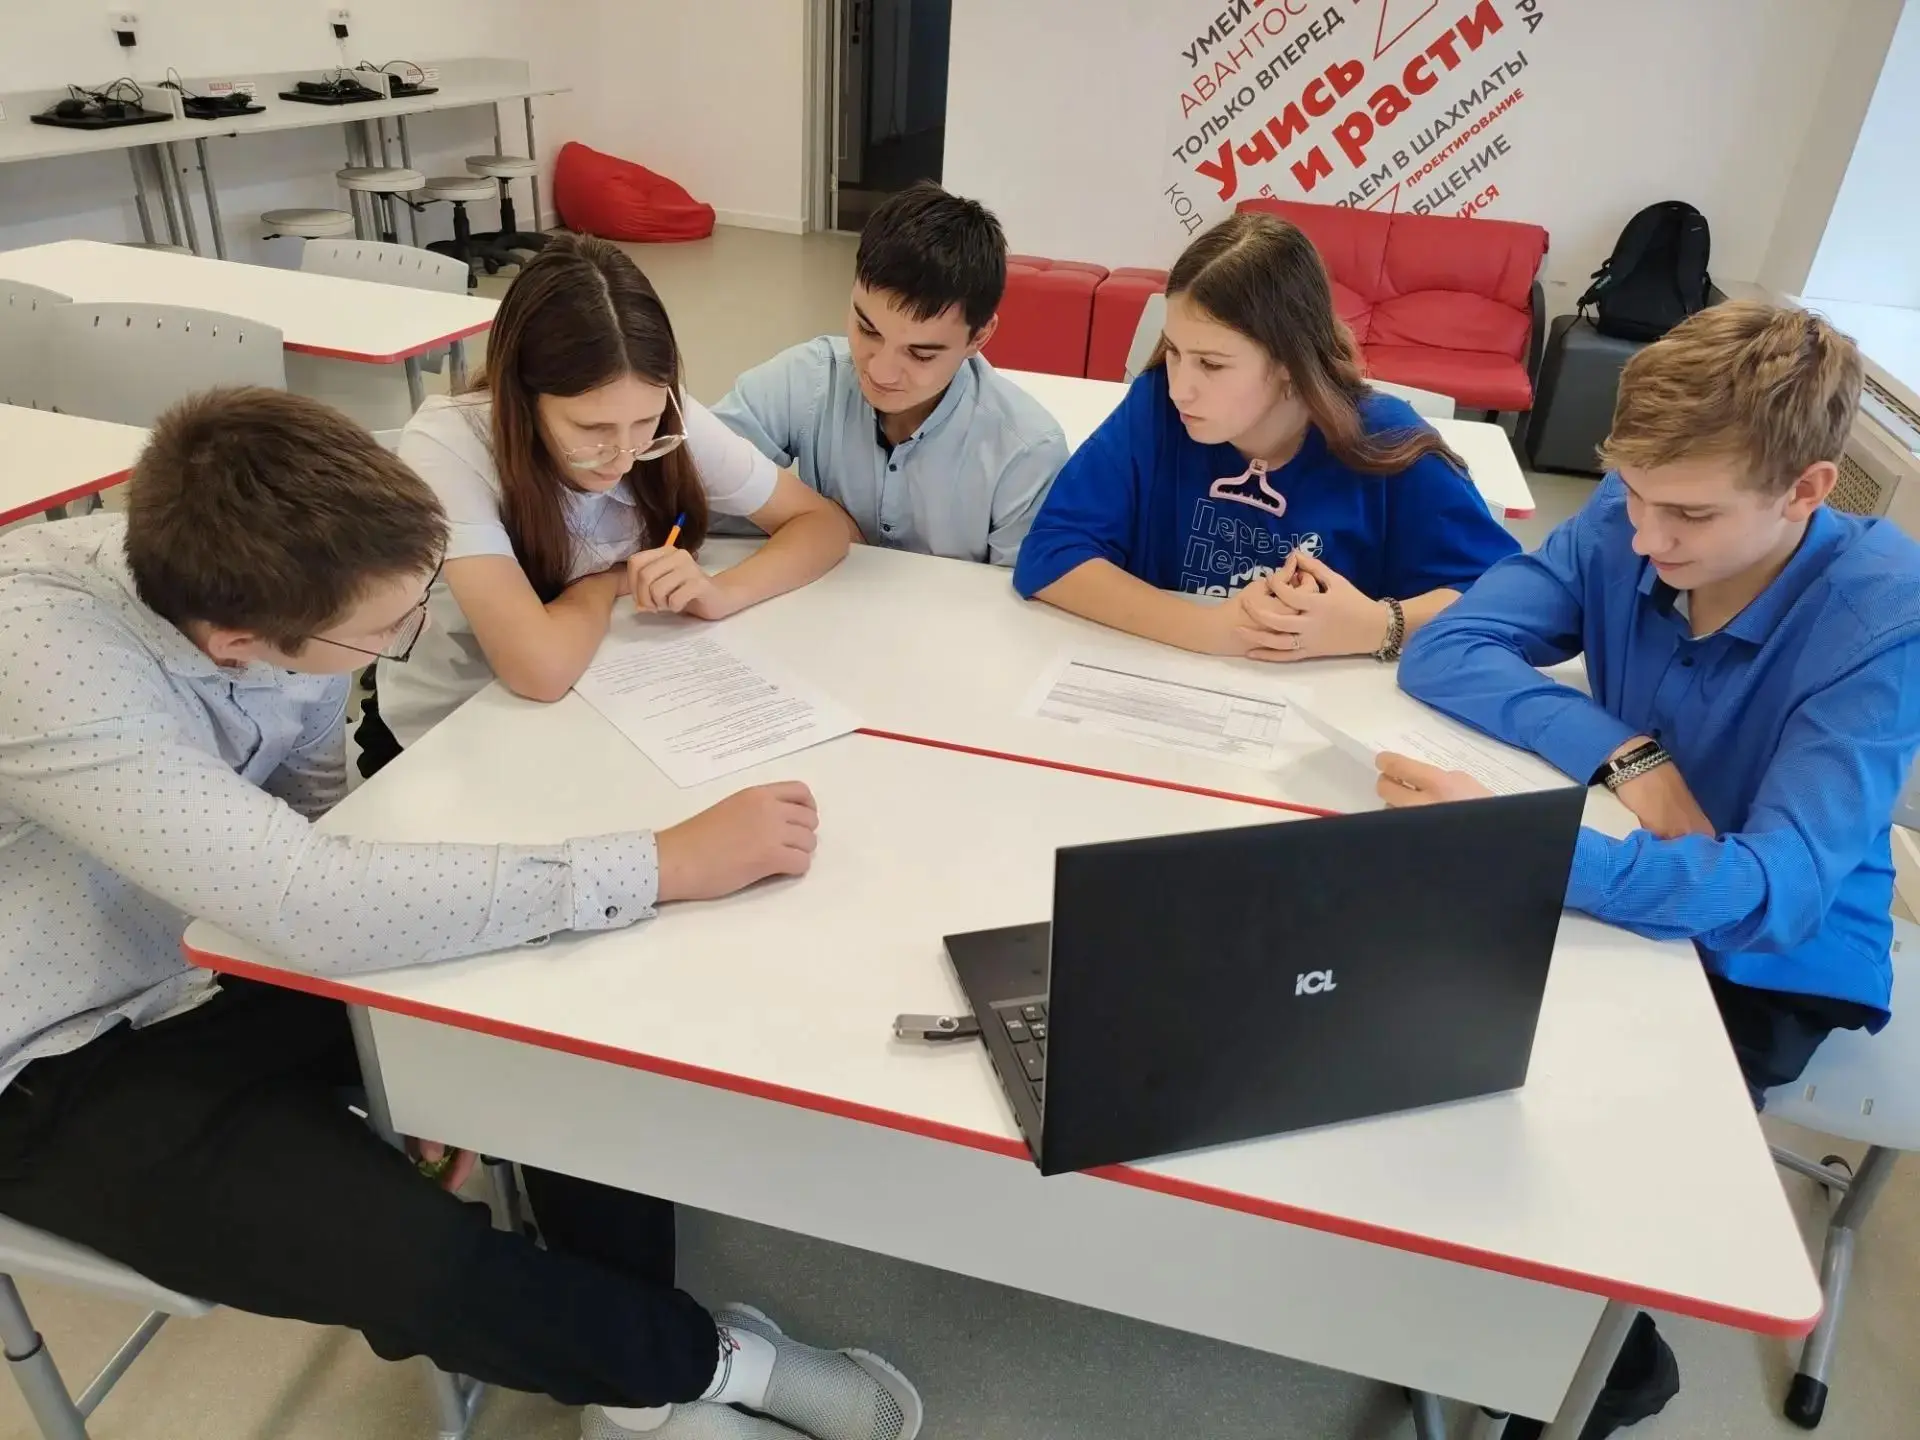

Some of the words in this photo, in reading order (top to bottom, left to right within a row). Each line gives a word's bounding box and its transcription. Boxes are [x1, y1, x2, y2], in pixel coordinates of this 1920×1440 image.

[1172, 86, 1255, 164] ТОЛЬКО
[1255, 6, 1345, 91] ВПЕРЕД
[1194, 58, 1365, 202] Учись
[1289, 144, 1335, 193] и
[1331, 0, 1505, 169] расти
[1391, 149, 1411, 170] В
[1409, 50, 1530, 155] ШАХМАТЫ
[1405, 88, 1525, 188] ПРОЕКТИРОВАНИЕ
[1405, 134, 1512, 216] БЩЕНИЕ
